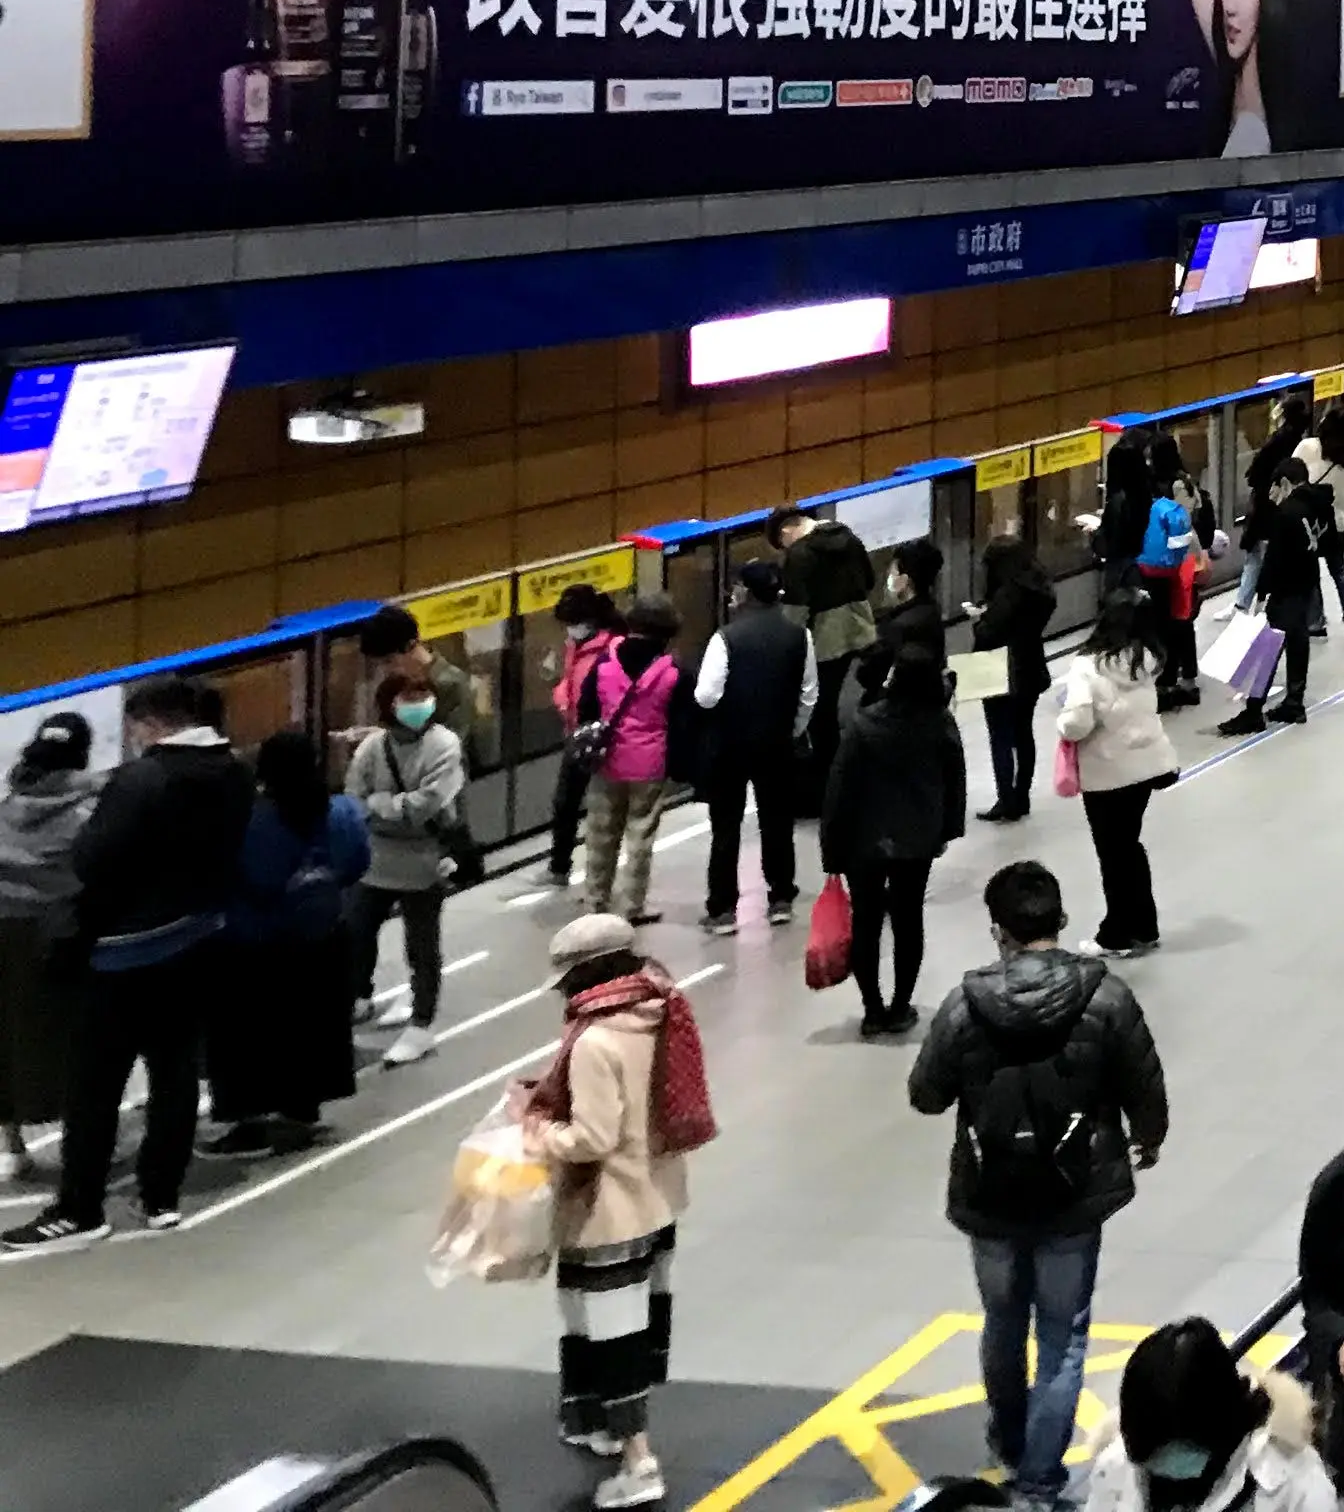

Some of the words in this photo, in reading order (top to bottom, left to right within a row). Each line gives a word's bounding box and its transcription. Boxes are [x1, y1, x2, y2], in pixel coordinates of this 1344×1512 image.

[966, 77, 1026, 102] momo
[971, 220, 1023, 255] 市政府
